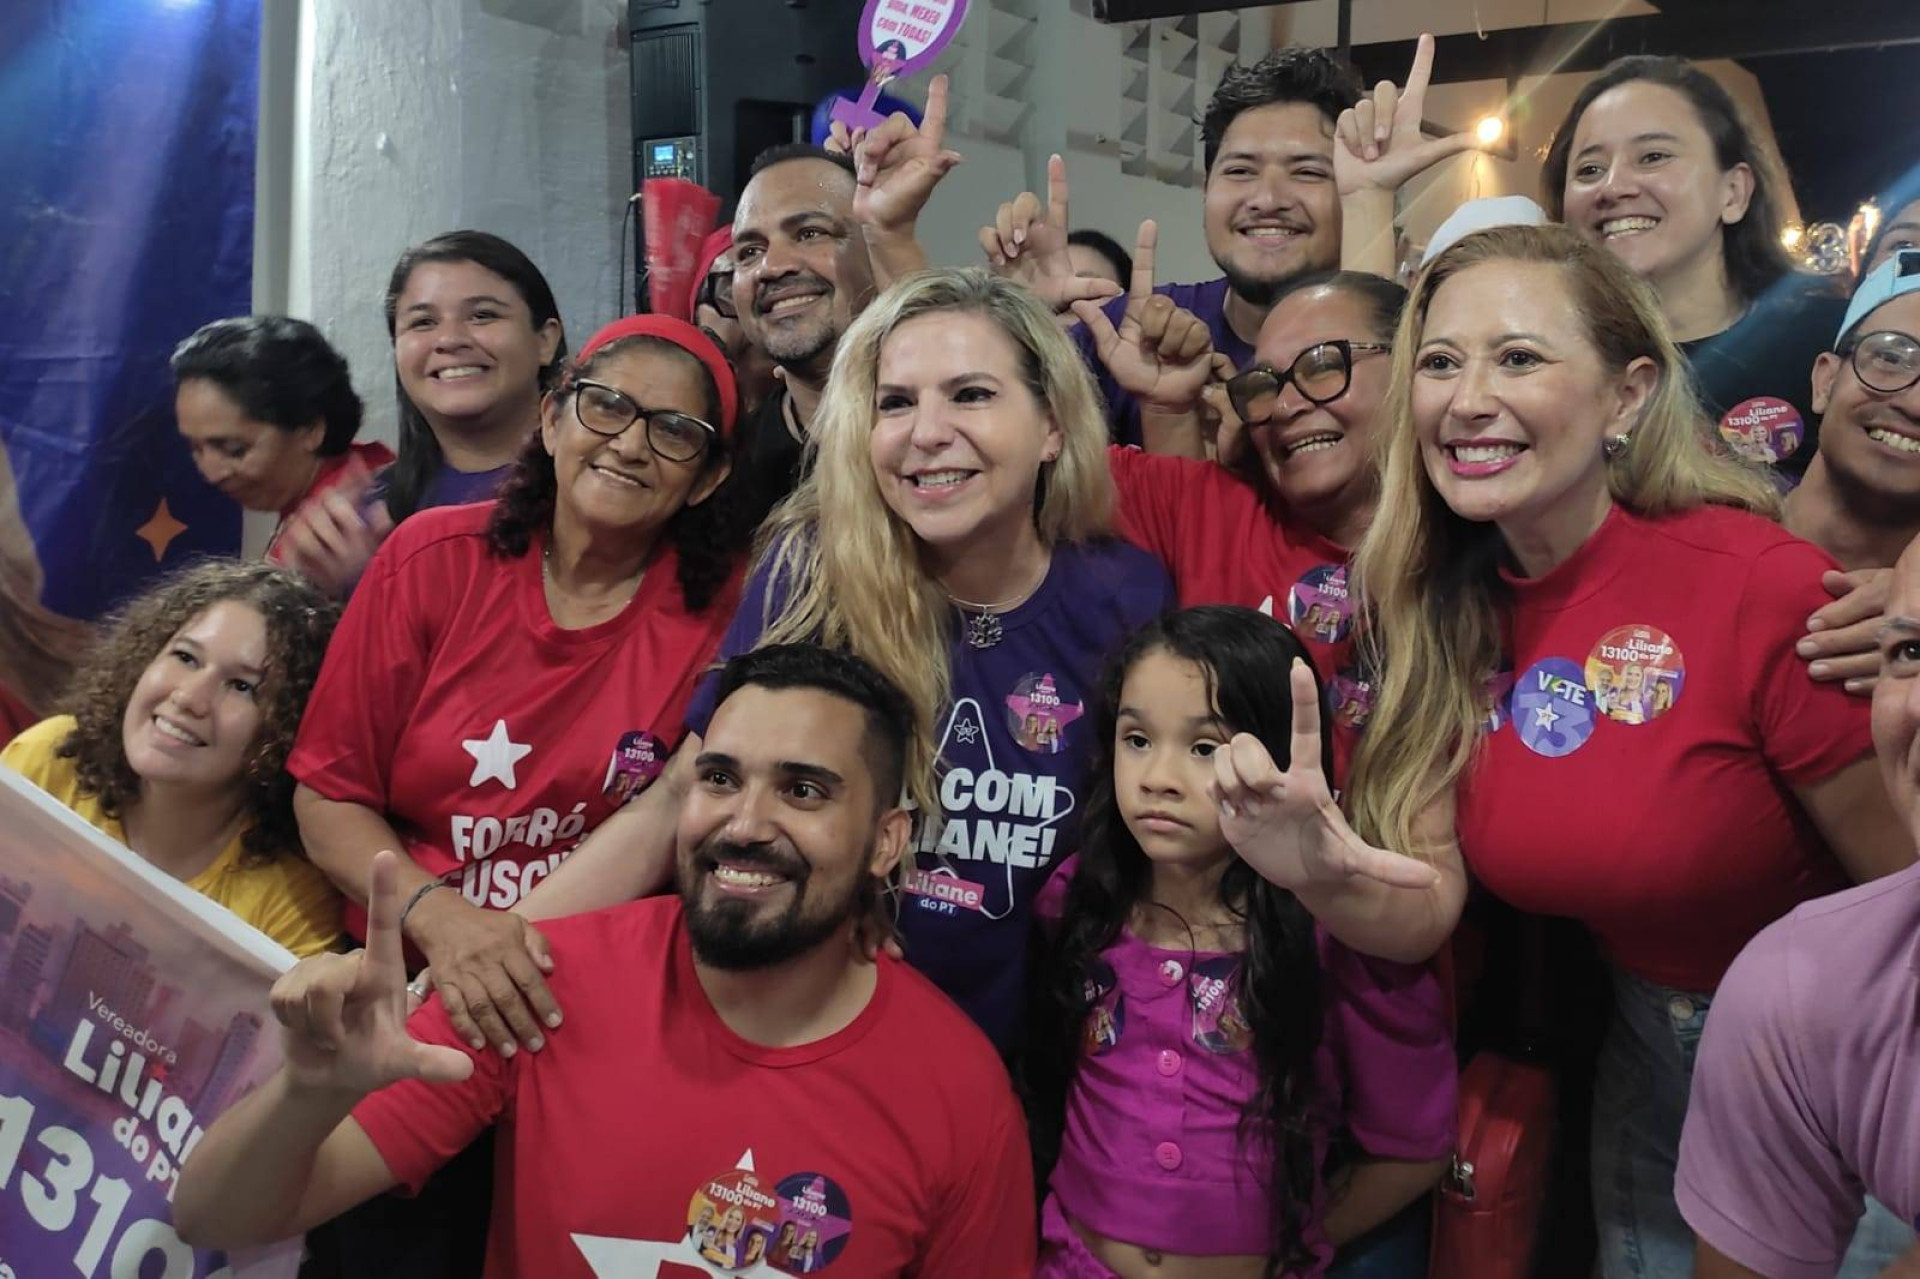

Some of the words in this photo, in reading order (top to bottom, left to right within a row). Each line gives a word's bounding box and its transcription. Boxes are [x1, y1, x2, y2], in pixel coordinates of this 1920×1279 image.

[1318, 583, 1348, 598] 13100
[1601, 645, 1638, 661] 13100
[1030, 692, 1060, 706] 13100
[625, 747, 655, 762] 13100
[940, 767, 1057, 819] COM
[904, 872, 978, 905] Liliane
[921, 897, 937, 911] do
[939, 900, 957, 914] PT
[1197, 978, 1224, 1009] 13100
[88, 990, 177, 1064] Vereadora
[113, 1117, 149, 1162] do
[709, 1182, 743, 1206] 13100
[792, 1195, 827, 1216] 13100
